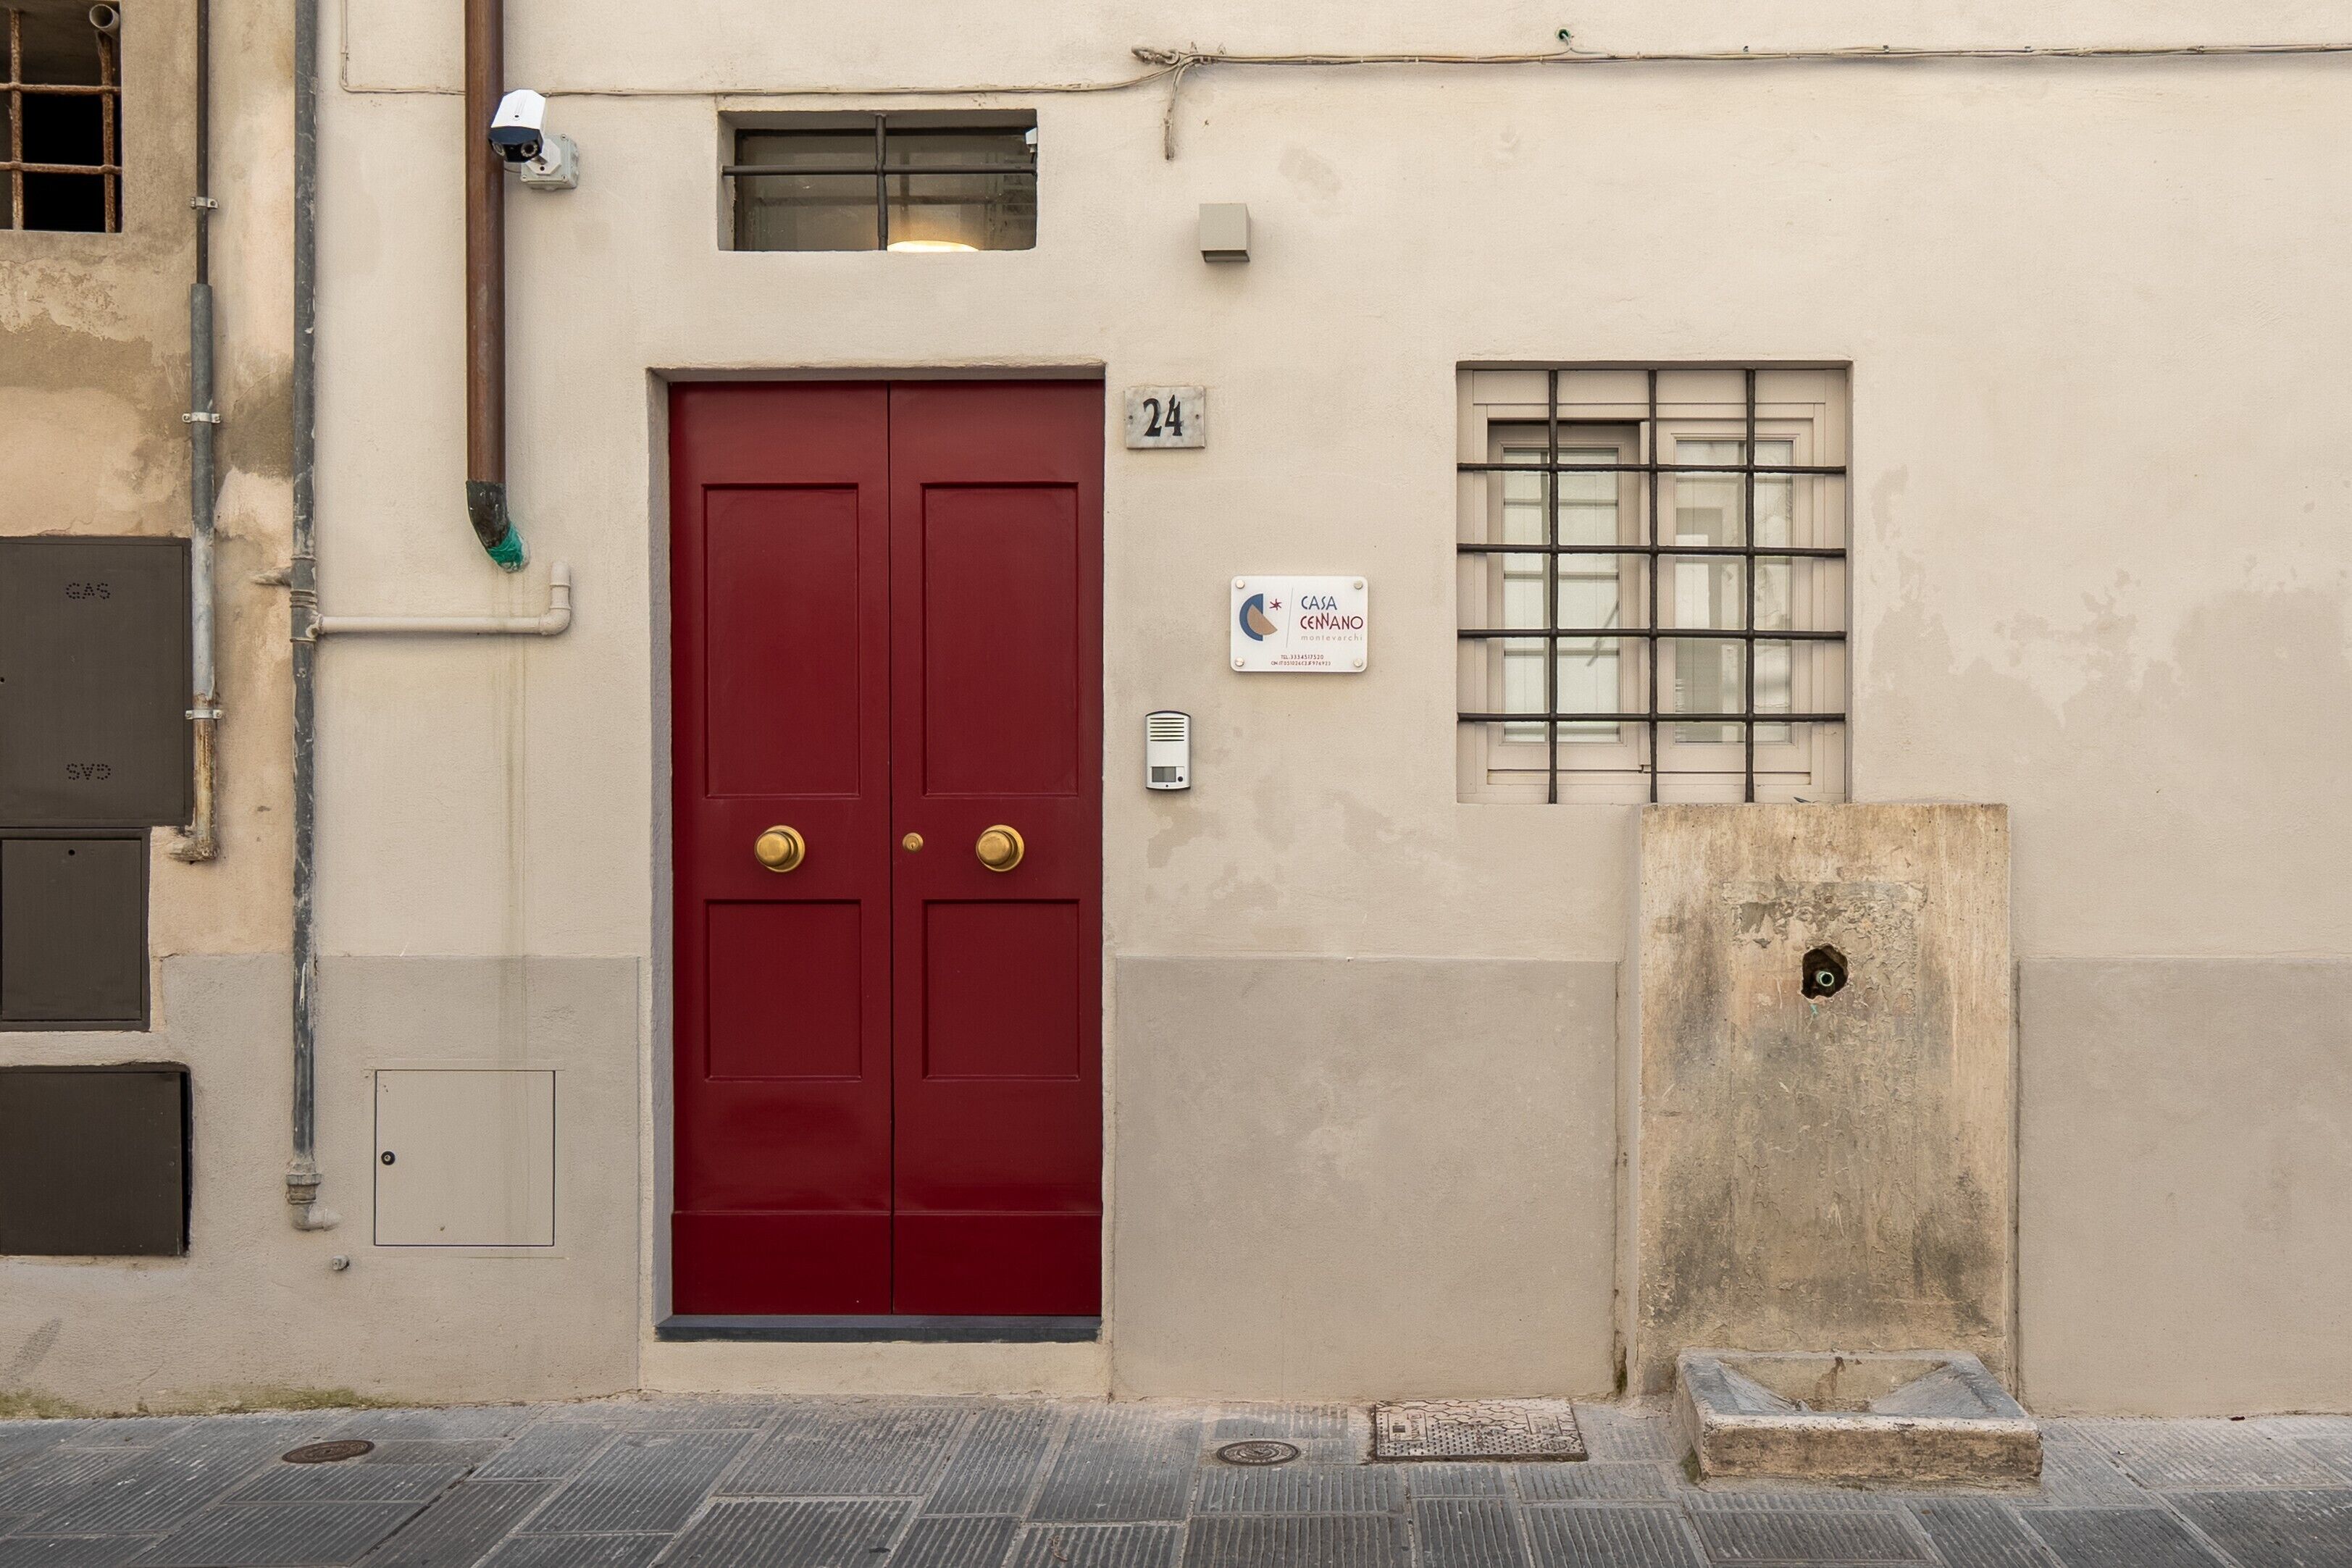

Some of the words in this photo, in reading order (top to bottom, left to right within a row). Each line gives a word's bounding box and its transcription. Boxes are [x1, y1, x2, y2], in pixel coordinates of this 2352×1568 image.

[1142, 394, 1183, 437] 24
[65, 582, 111, 600] GAS
[1300, 595, 1337, 611] CASA
[1300, 612, 1364, 630] CENNANO
[1300, 633, 1363, 642] montevarchi
[65, 763, 111, 781] GAS
